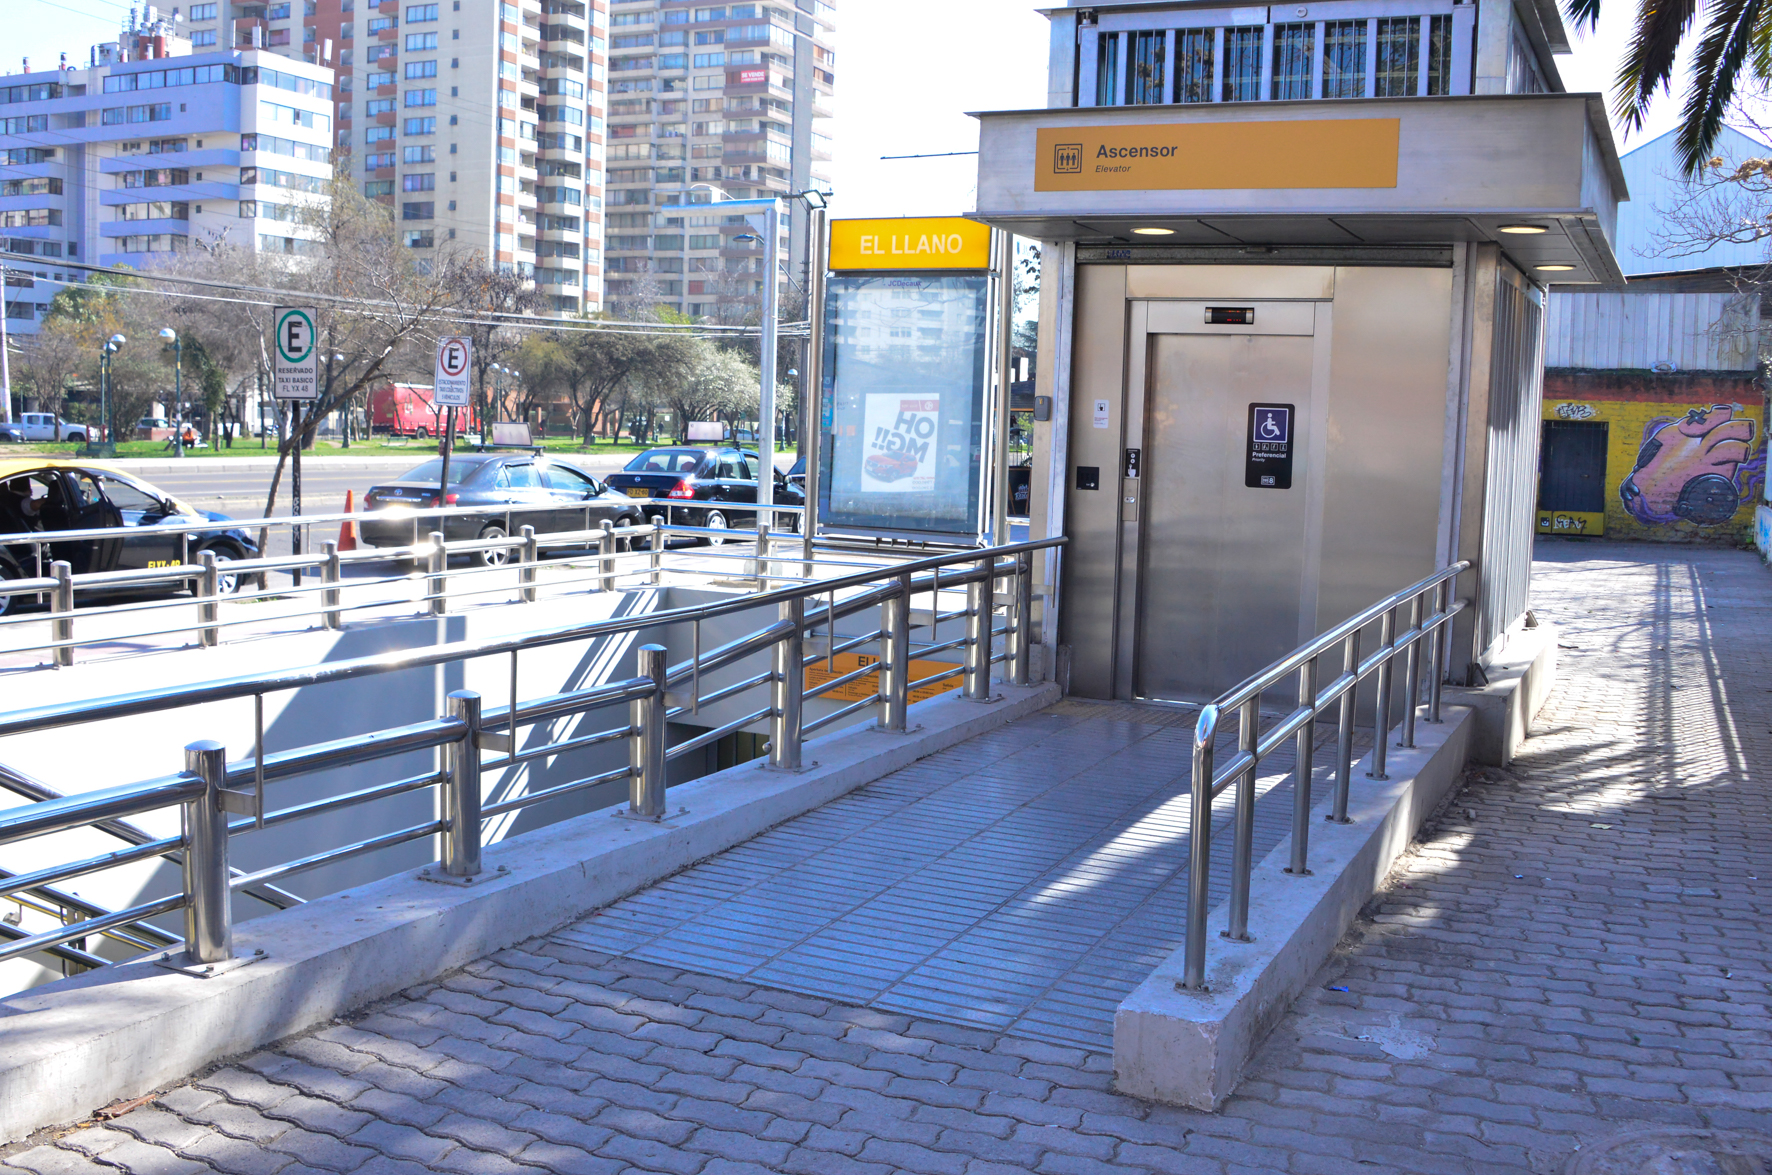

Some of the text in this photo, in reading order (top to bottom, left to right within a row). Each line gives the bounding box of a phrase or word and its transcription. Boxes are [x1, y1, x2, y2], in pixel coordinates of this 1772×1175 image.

[1096, 144, 1178, 158] Ascensor
[860, 234, 962, 254] EL LLANO
[288, 322, 302, 352] E
[448, 348, 460, 370] E
